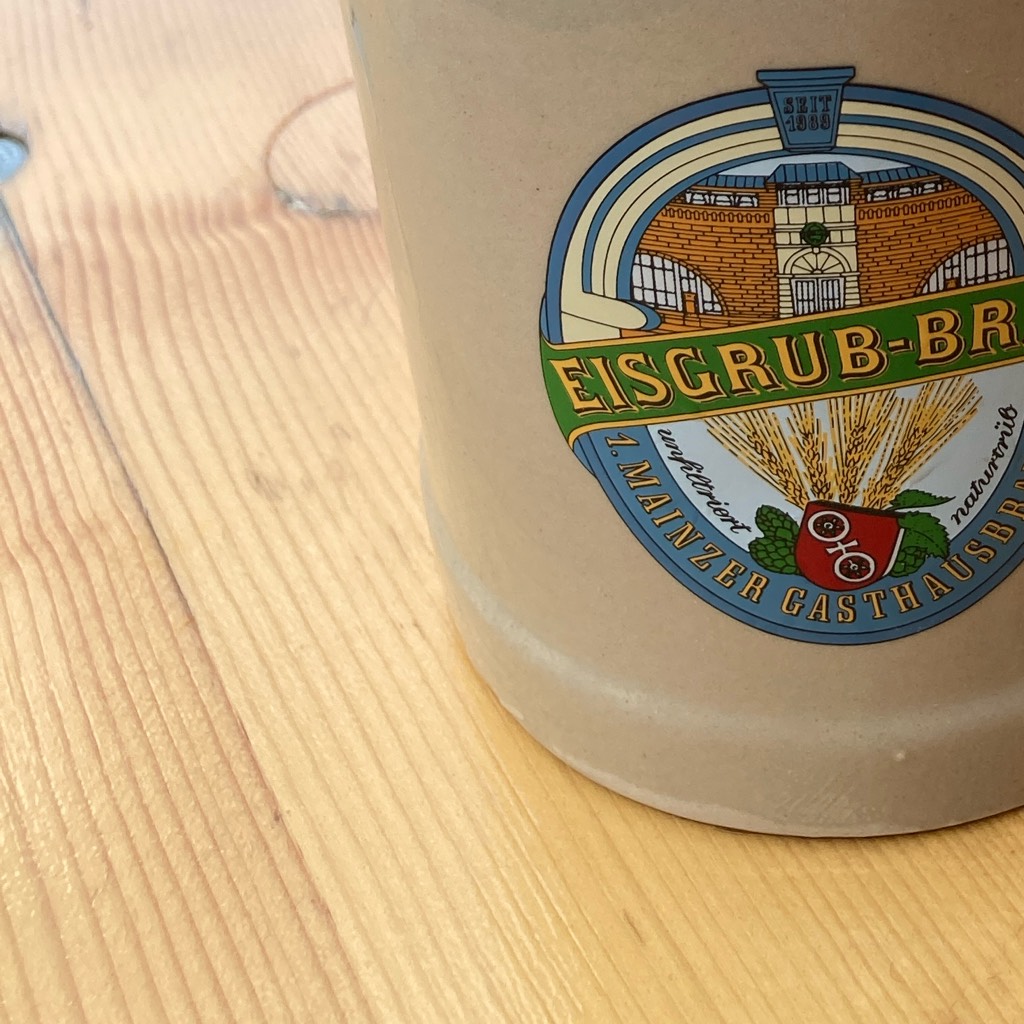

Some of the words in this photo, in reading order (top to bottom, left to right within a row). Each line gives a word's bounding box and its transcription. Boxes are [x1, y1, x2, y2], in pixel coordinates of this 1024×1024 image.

[783, 94, 832, 114] SEIT
[785, 113, 831, 132] 1989
[605, 432, 640, 457] 1.
[950, 403, 1018, 525] naturtrüb
[657, 428, 752, 534] unfiltriert
[617, 460, 769, 603] MAINZER
